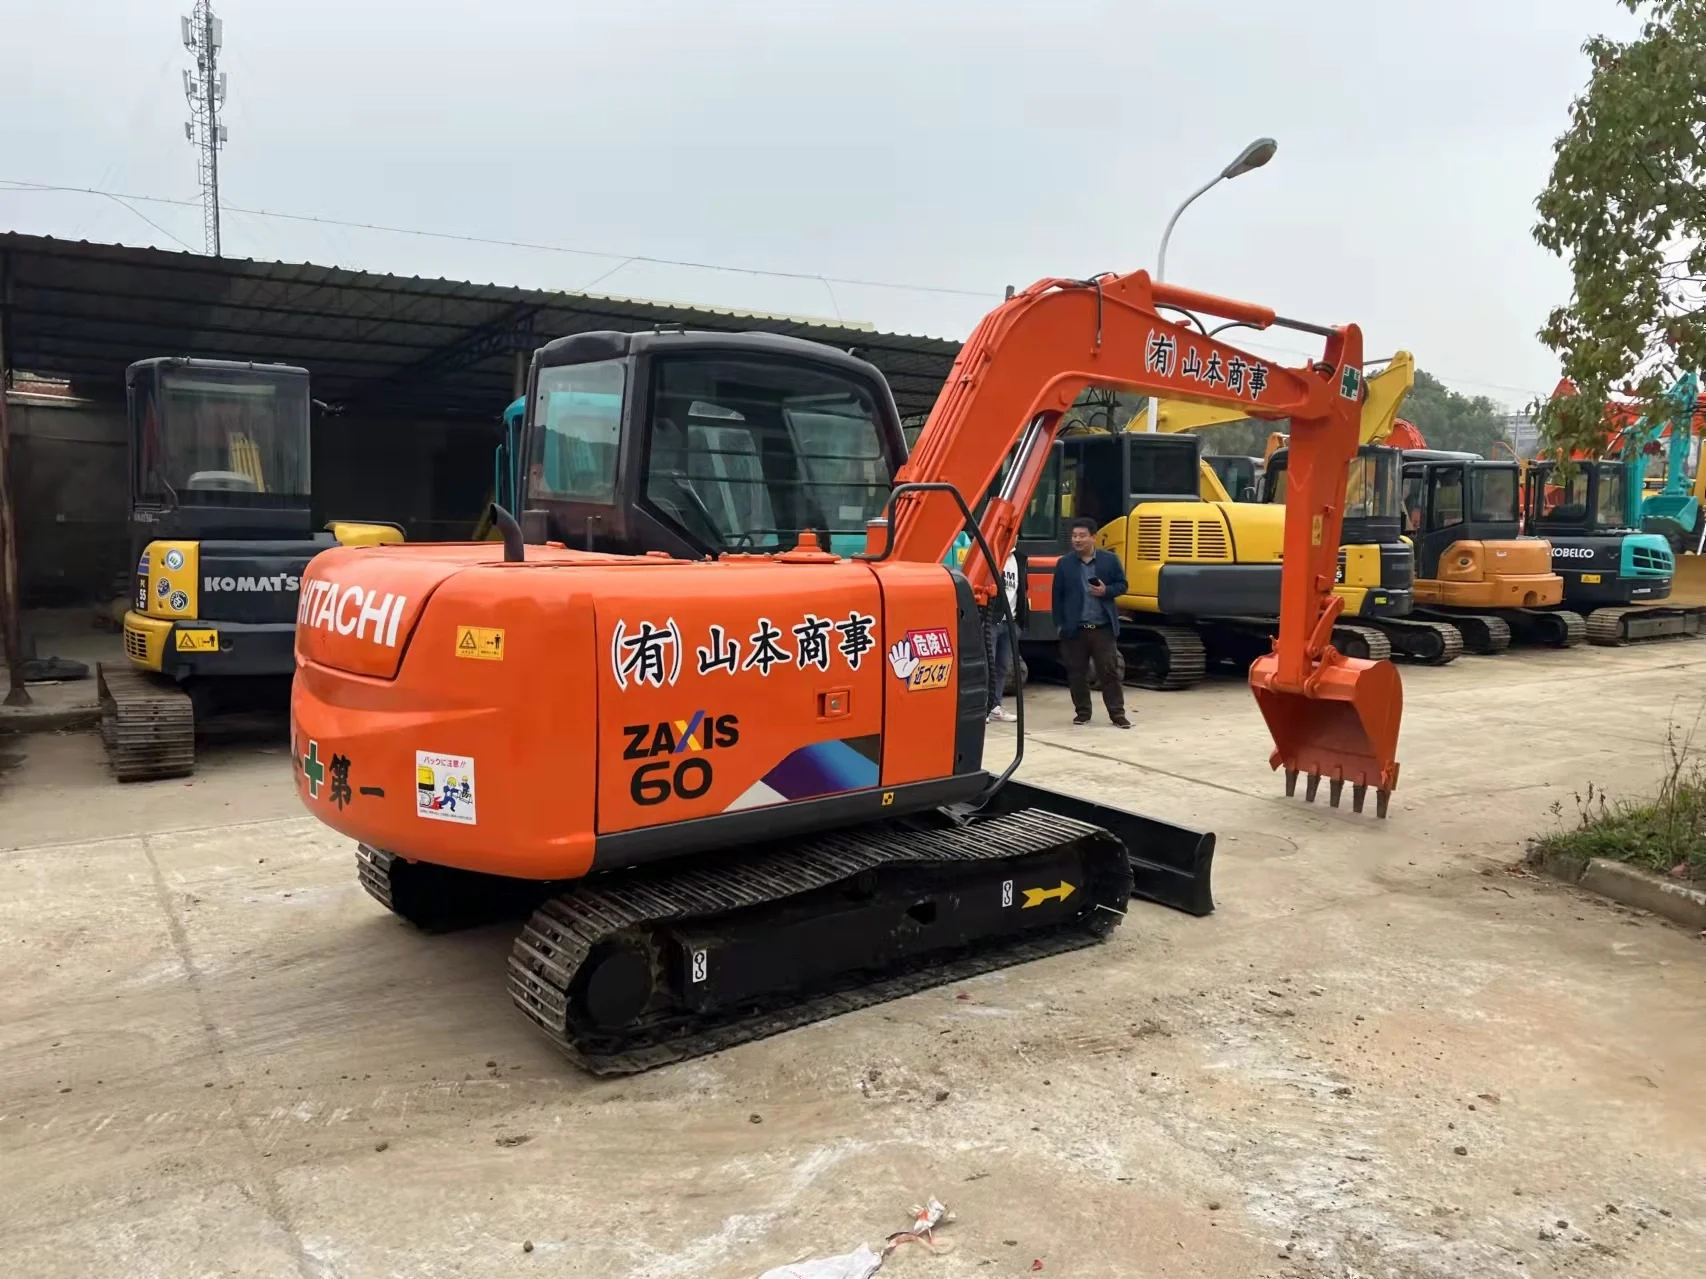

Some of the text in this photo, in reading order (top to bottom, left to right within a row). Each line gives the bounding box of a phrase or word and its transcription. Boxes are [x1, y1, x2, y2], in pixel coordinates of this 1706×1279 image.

[204, 573, 302, 592] KOMATS
[300, 579, 407, 648] HITACHI
[611, 610, 876, 692] (有)山本商事
[623, 709, 740, 761] ZAXIS
[630, 757, 713, 806] 60
